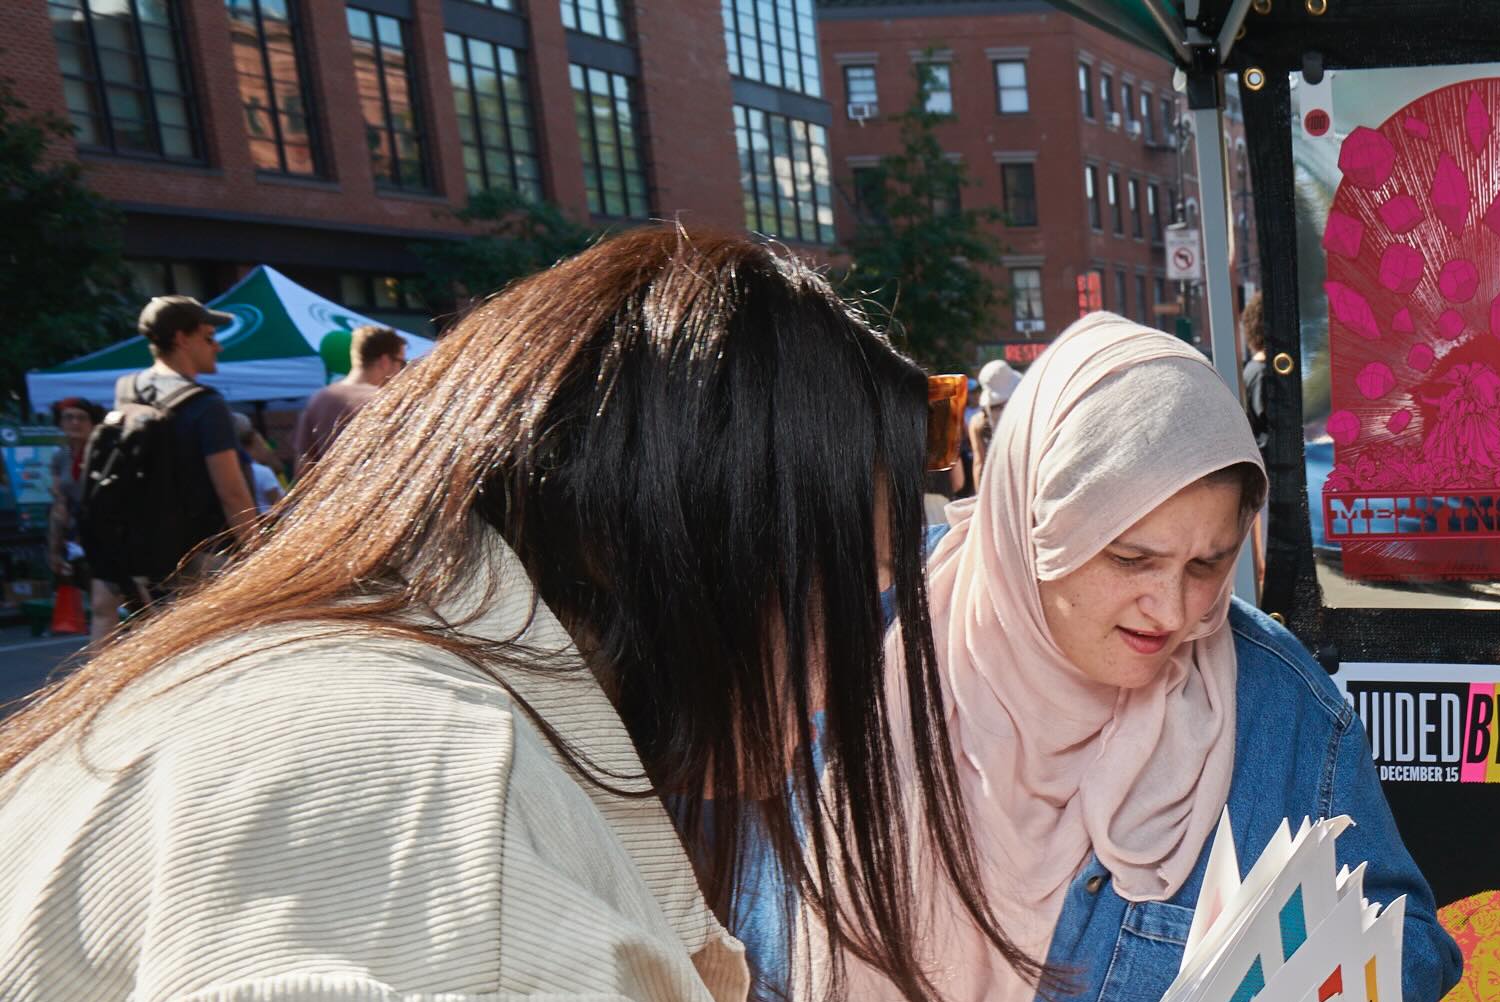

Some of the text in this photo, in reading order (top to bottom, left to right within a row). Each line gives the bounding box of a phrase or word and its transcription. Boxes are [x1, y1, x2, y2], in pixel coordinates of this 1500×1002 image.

[1347, 691, 1461, 763] UIDED
[1380, 766, 1443, 783] DECEMBER
[1445, 768, 1459, 783] 15
